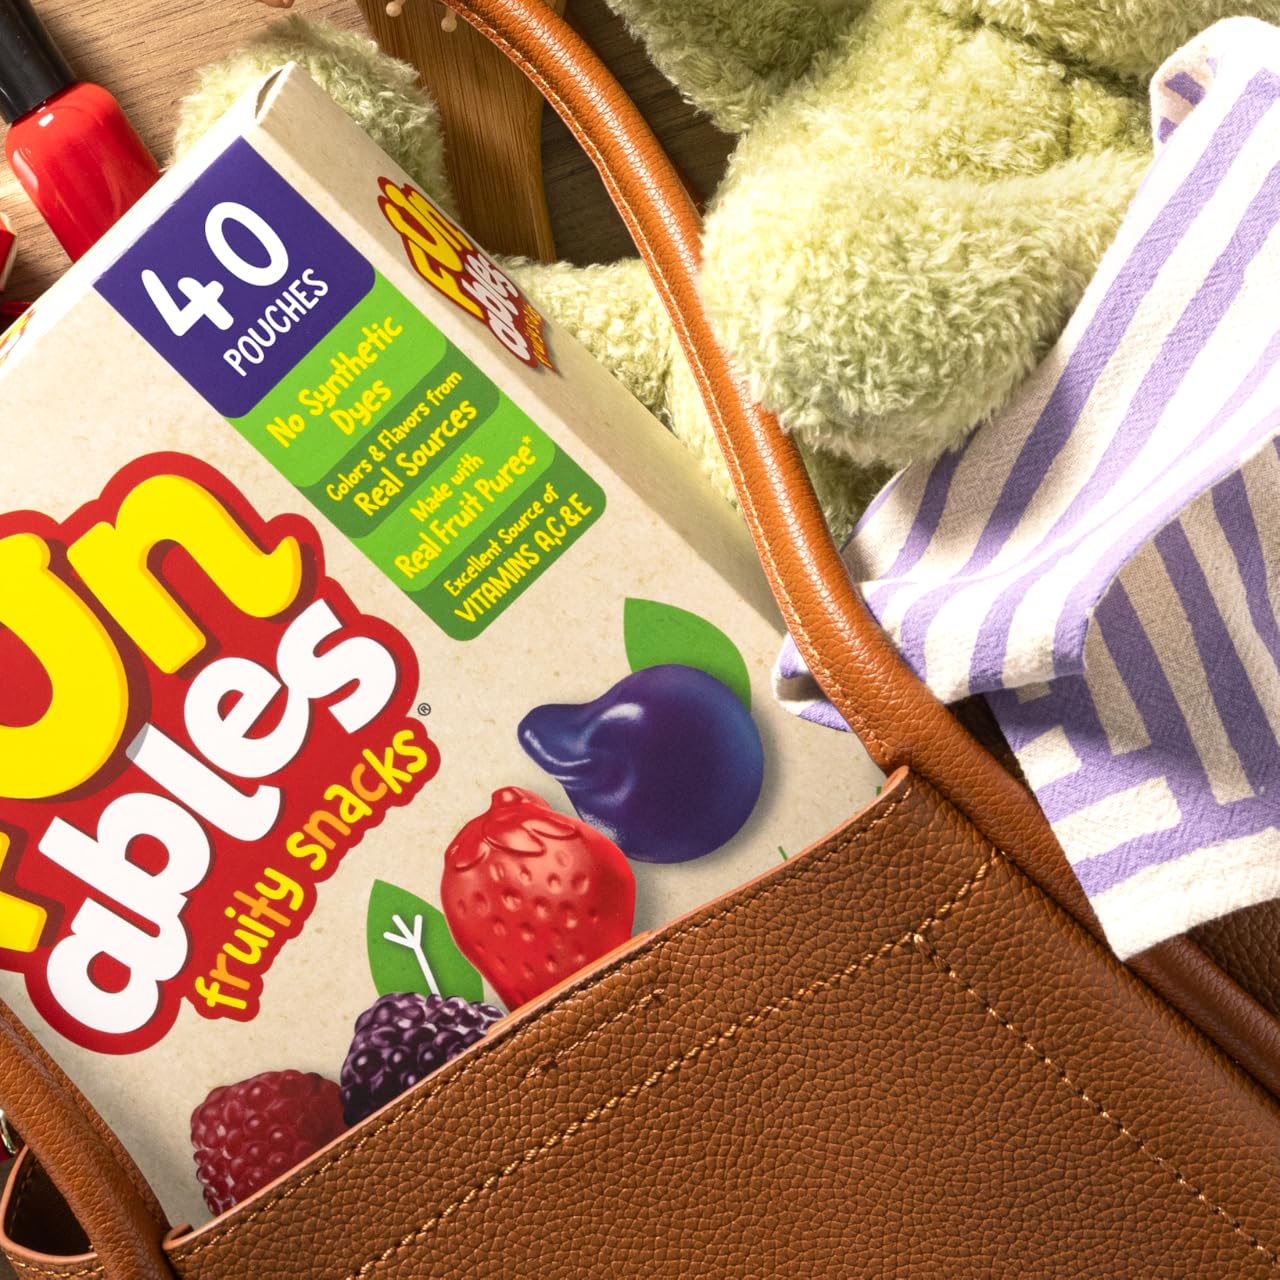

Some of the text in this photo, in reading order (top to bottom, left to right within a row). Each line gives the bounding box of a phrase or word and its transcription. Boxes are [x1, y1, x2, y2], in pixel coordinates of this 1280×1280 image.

[141, 201, 289, 337] 40
[223, 268, 329, 377] POUCHES
[266, 316, 403, 448] No Synthetic
[325, 371, 463, 502] Colors & Flavors from
[330, 379, 392, 436] Dyes
[353, 399, 477, 517] Real Sources
[409, 453, 484, 523] Made with
[394, 531, 442, 579] Real
[429, 491, 484, 545] Fruit
[443, 482, 560, 598] Excellent Source of
[454, 543, 540, 623] VITAMINS
[38, 598, 397, 1035] ables
[194, 729, 428, 1010] fruity snacks
